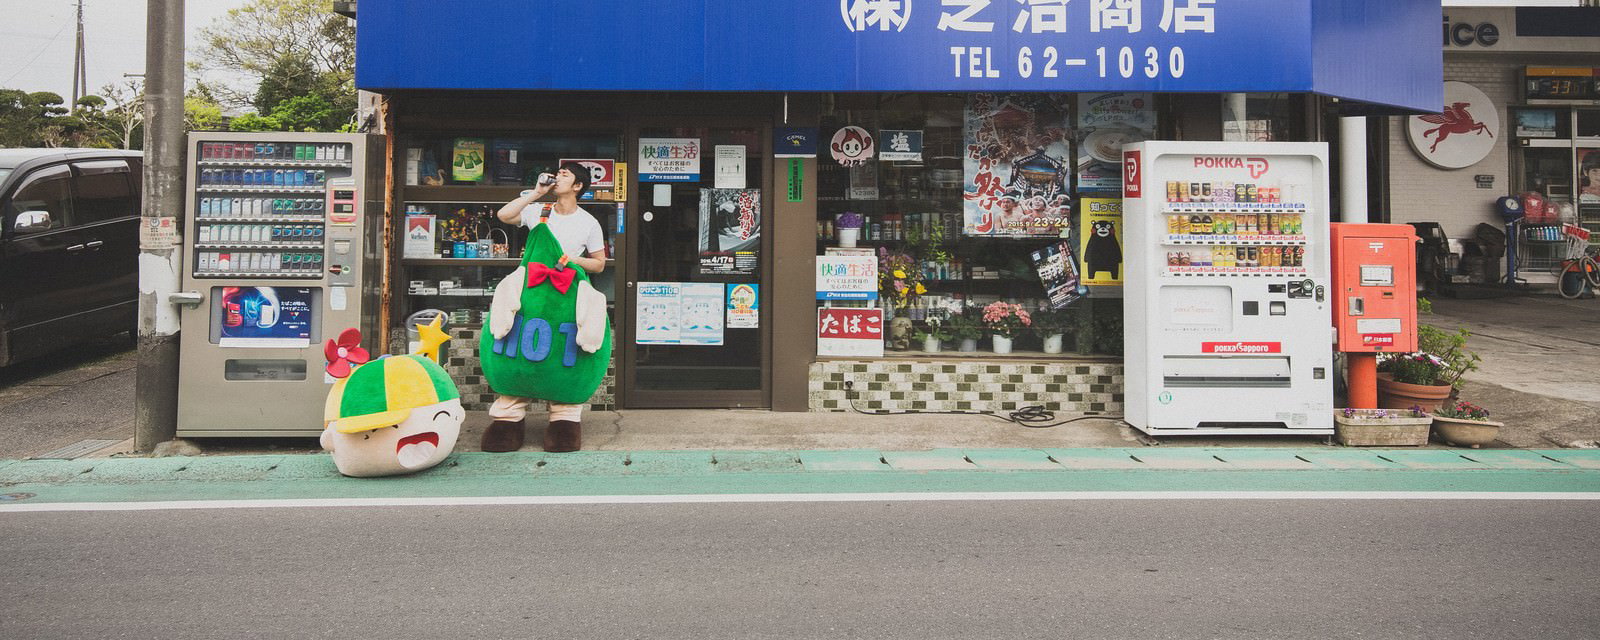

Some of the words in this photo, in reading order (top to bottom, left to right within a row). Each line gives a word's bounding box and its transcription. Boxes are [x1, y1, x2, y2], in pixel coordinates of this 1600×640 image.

[951, 46, 1000, 78] TEL
[890, 132, 911, 152] 塩
[641, 144, 698, 159] 快適生活
[1194, 156, 1244, 168] POKKA
[821, 263, 875, 277] 快適生活
[820, 313, 881, 334] たばこ
